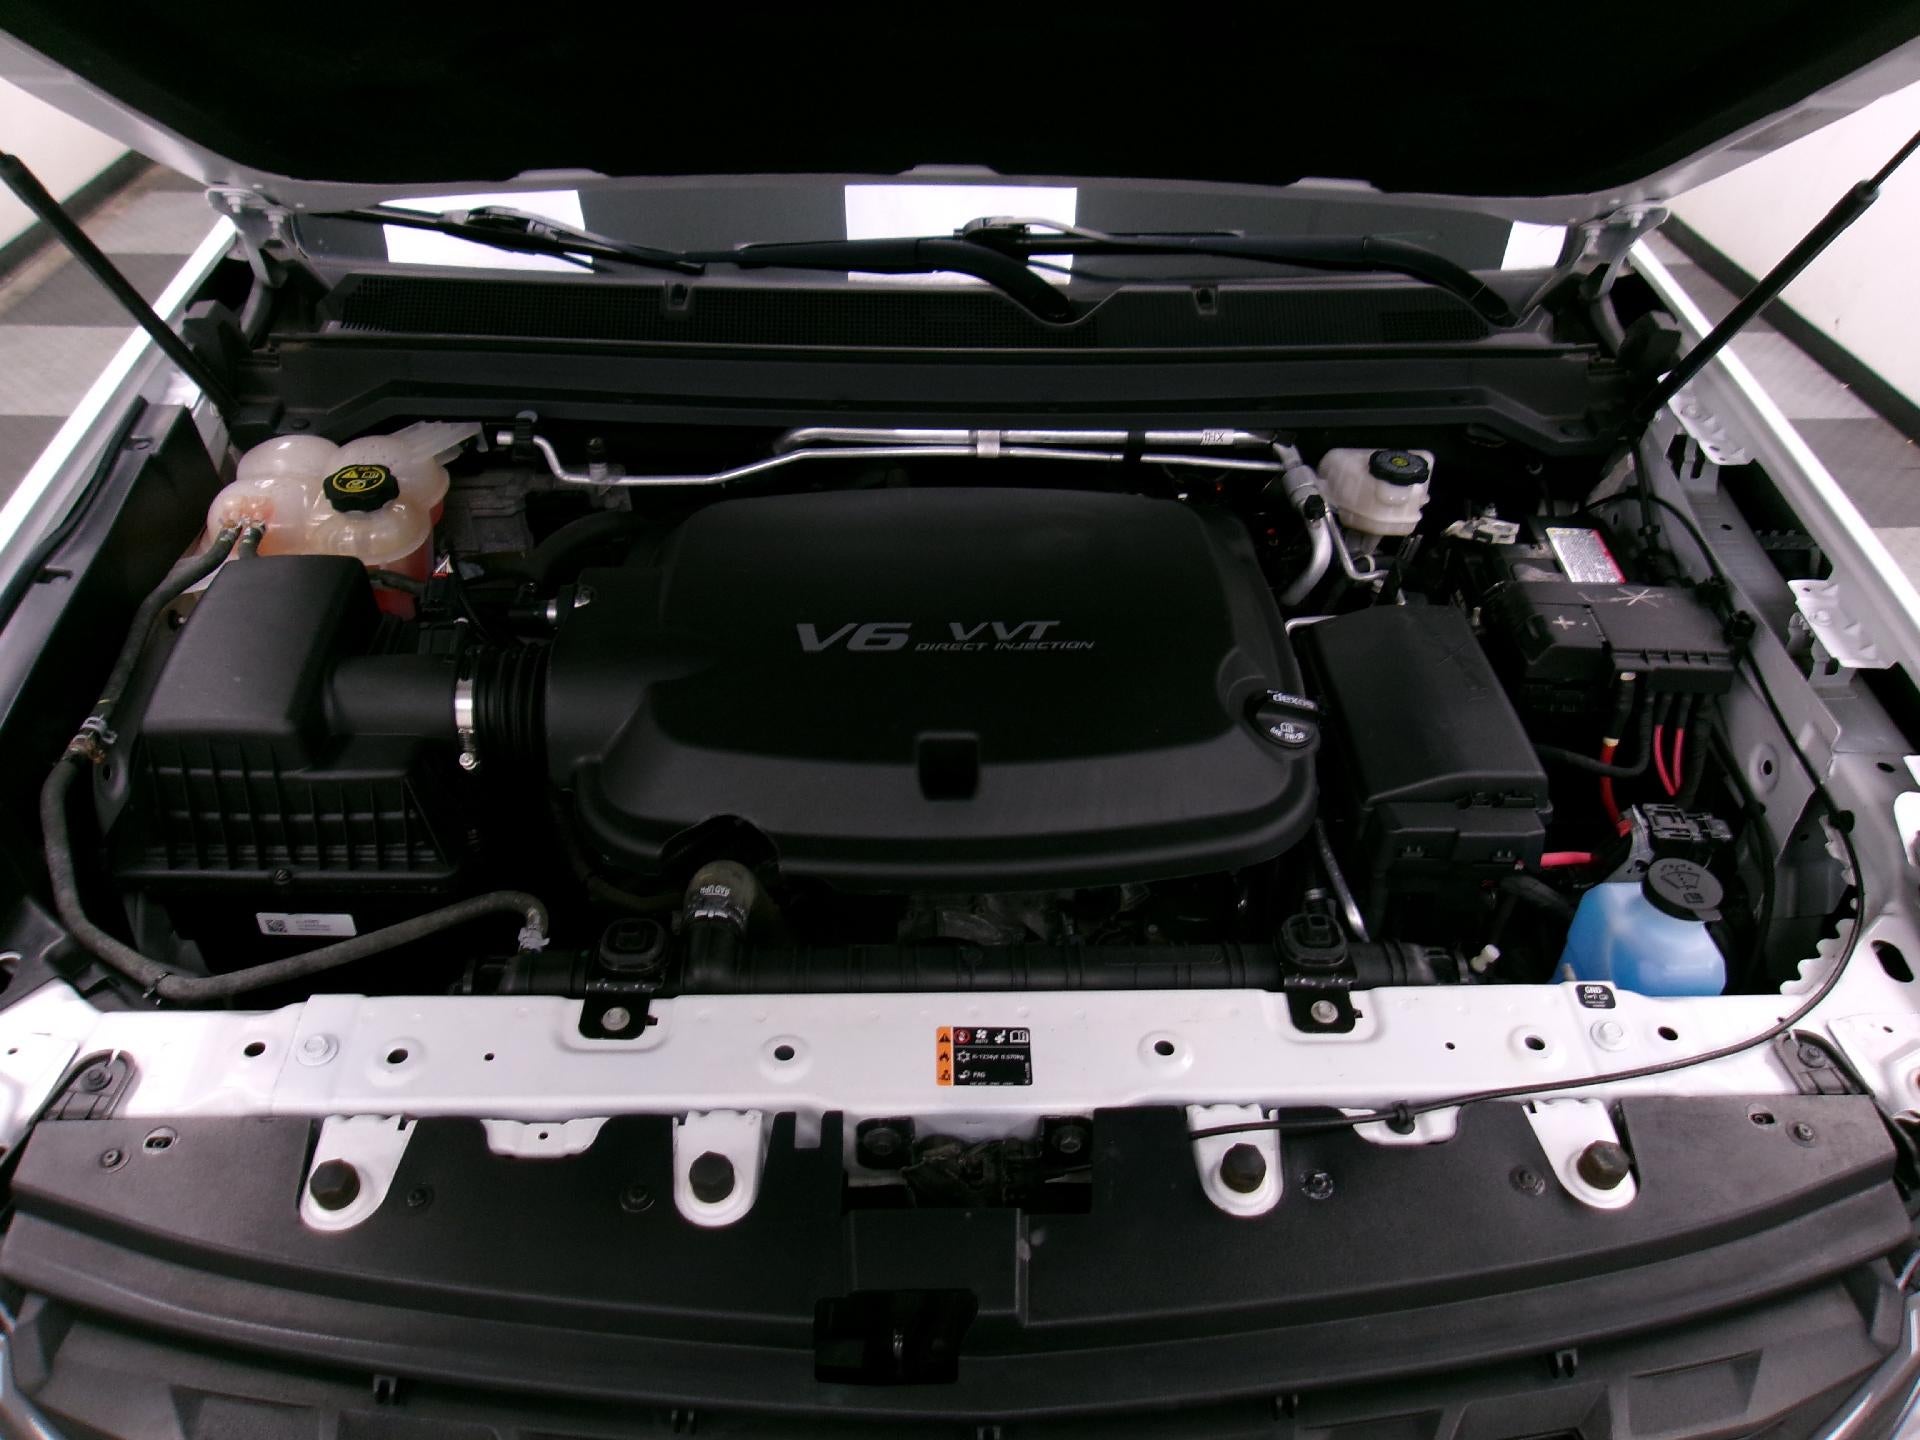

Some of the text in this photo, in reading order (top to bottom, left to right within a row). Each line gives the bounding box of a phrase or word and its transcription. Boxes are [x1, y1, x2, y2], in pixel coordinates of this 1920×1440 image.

[796, 622, 912, 652] V6
[949, 620, 1060, 642] VVT
[914, 640, 1095, 651] DIRECT INJECTION
